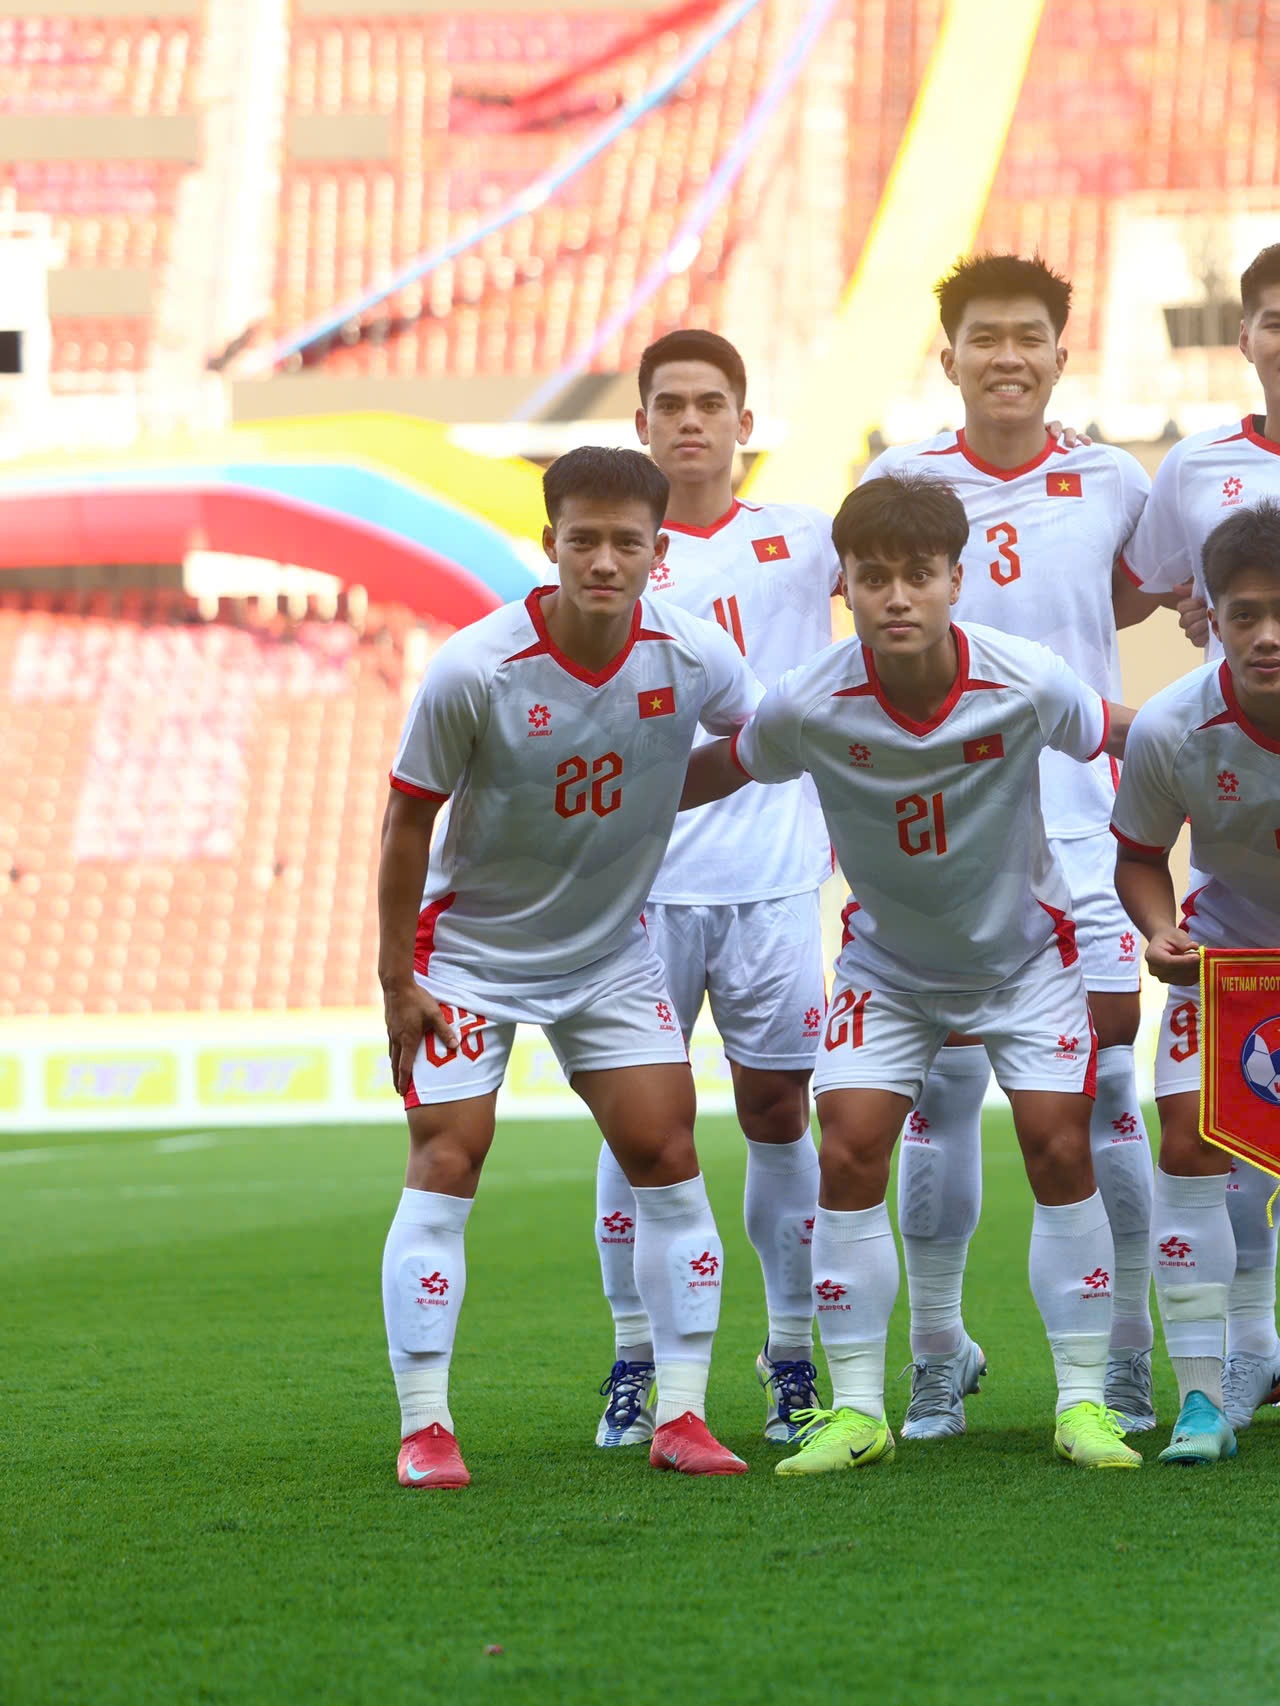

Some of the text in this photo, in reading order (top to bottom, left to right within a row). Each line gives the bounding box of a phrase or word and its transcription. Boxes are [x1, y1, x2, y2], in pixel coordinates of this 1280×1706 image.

[986, 522, 1021, 587] 3
[555, 752, 623, 820] 22
[896, 792, 948, 857] 21
[1221, 975, 1257, 992] VIETNAM
[823, 988, 873, 1053] 21
[1169, 1000, 1199, 1063] 9
